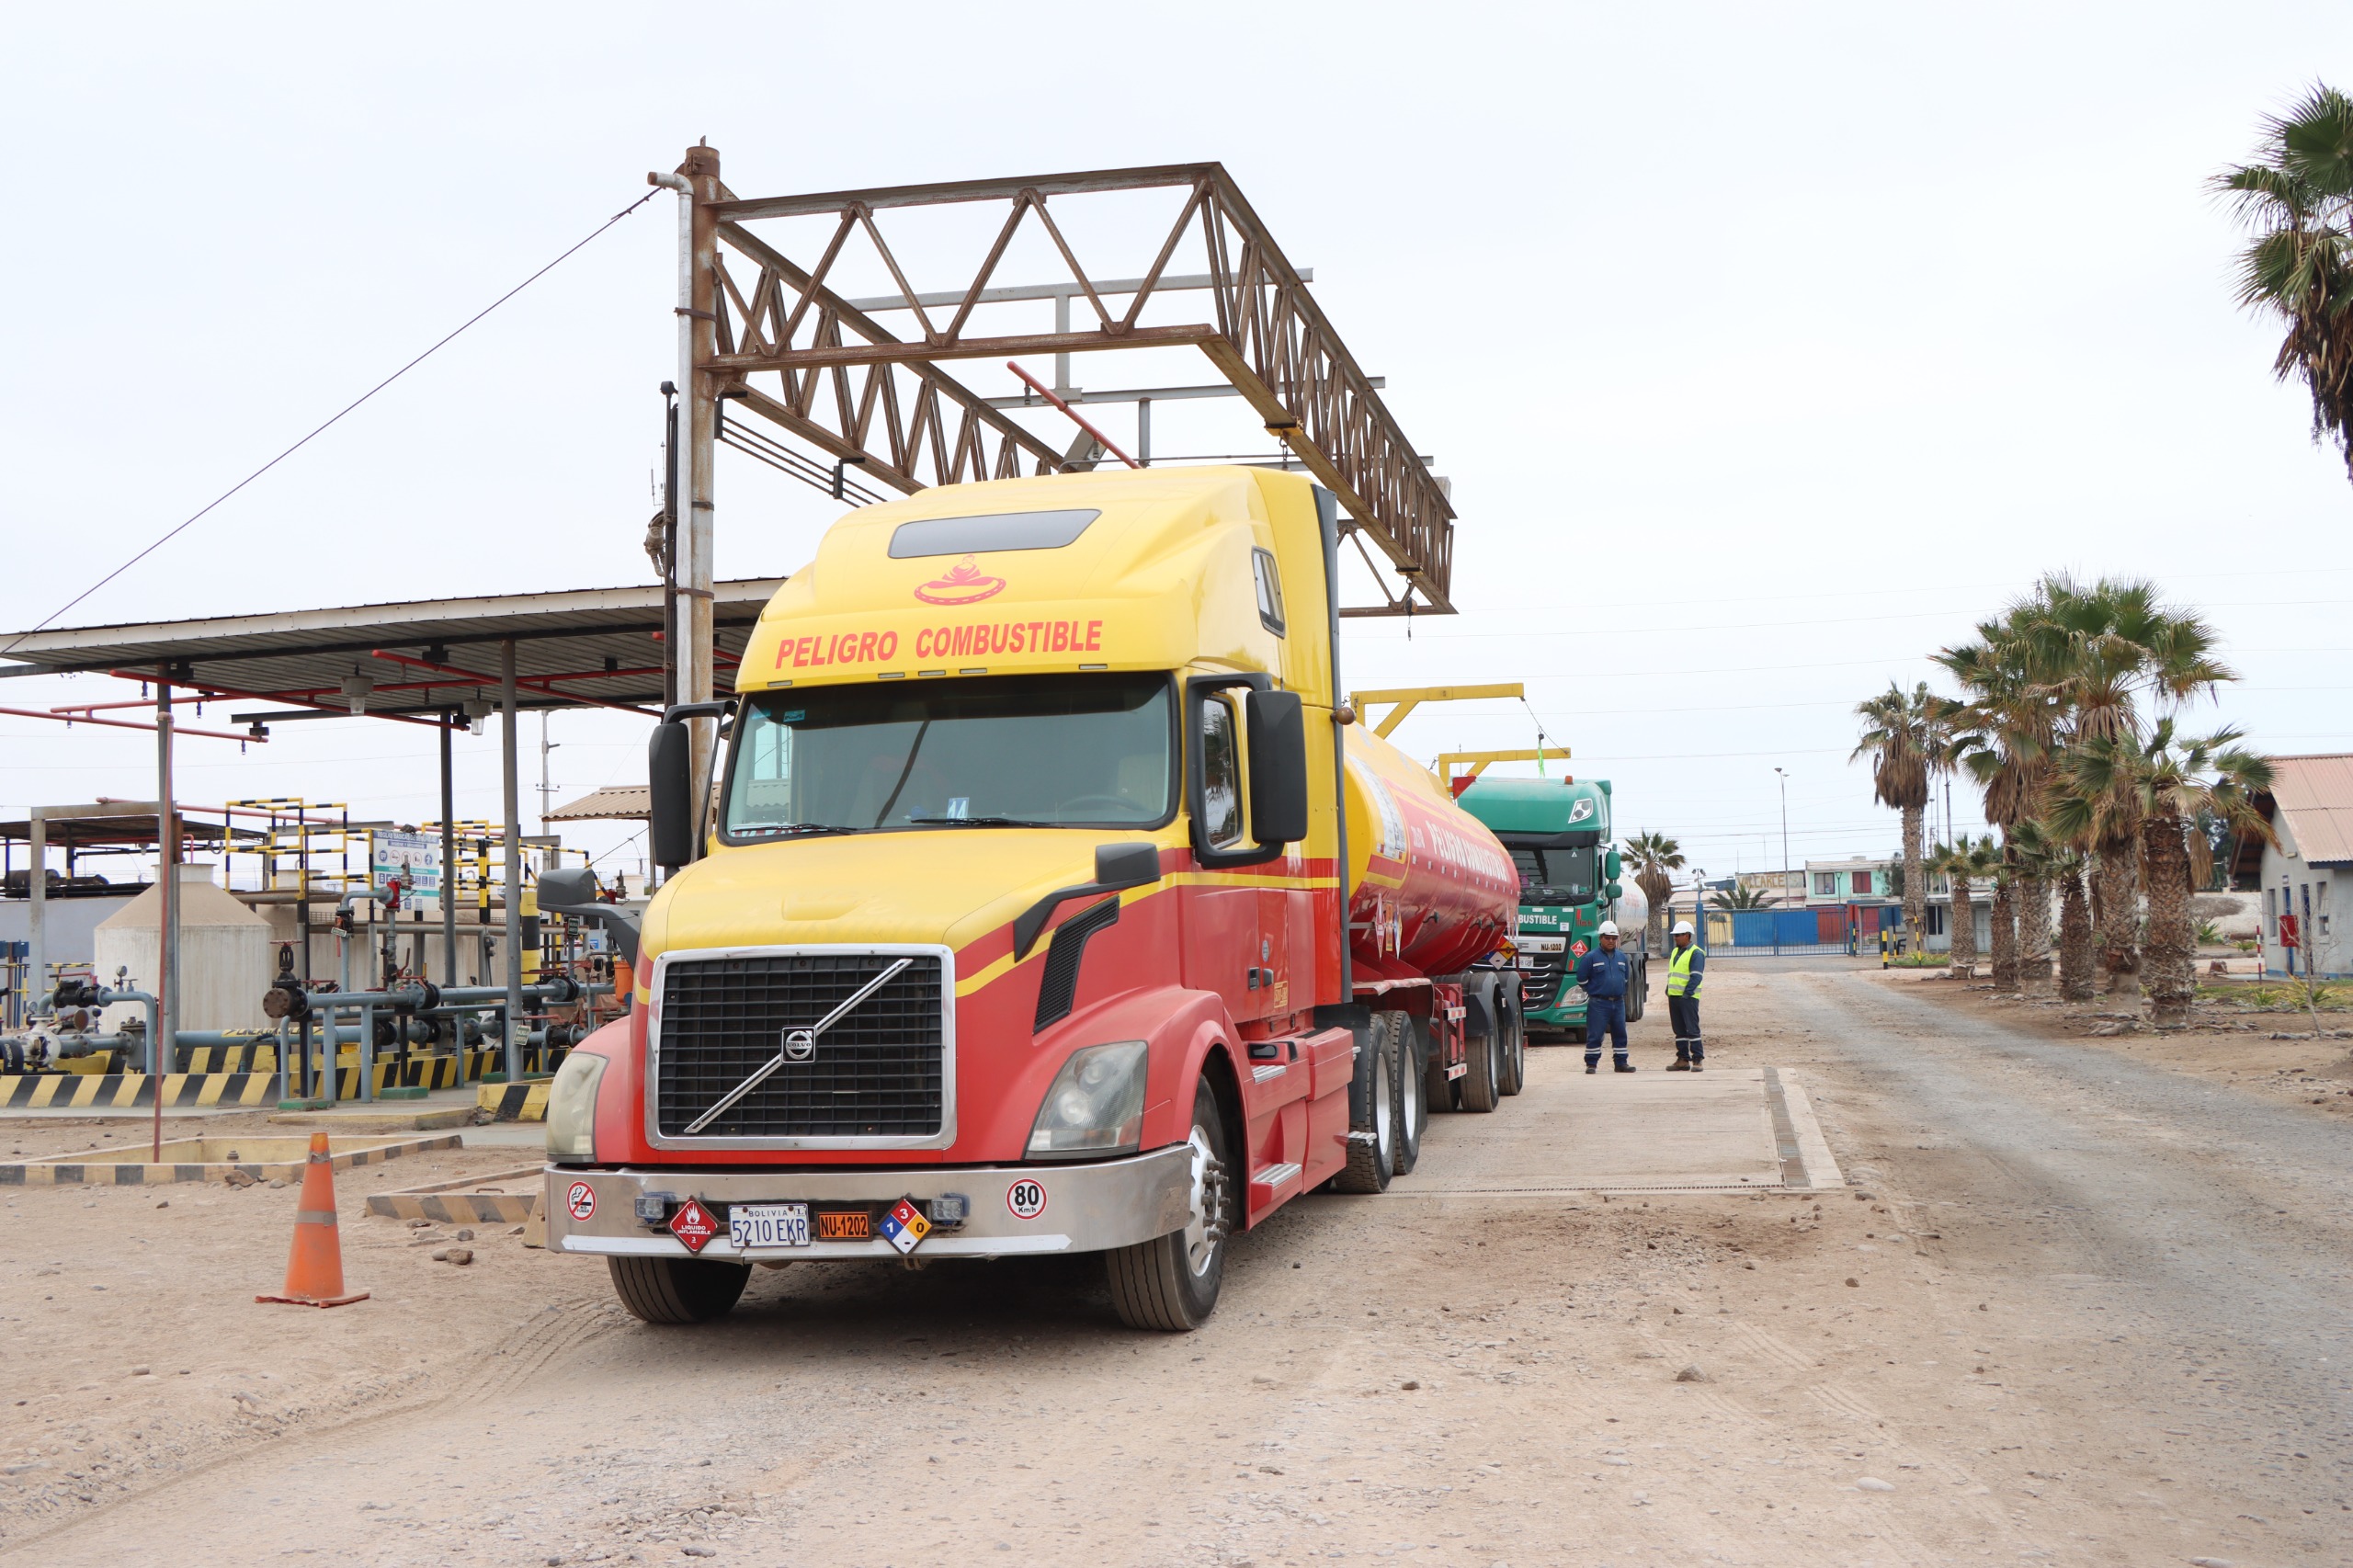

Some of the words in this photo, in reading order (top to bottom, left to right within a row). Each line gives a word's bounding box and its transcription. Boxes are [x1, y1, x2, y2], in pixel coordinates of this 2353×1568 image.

[775, 631, 899, 669] PELIGRO
[915, 620, 1104, 659] COMBUSTIBLE
[1426, 820, 1466, 868] PELIGRO
[1519, 915, 1557, 925] BUSTIBLE
[1015, 1185, 1040, 1206] 80
[749, 1210, 788, 1218] BOLIVIA
[900, 1209, 908, 1220] 3
[732, 1220, 772, 1243] 5210
[777, 1218, 806, 1242] EKR
[821, 1215, 868, 1236] NU-1202
[886, 1222, 895, 1233] 1
[915, 1222, 925, 1233] 0
